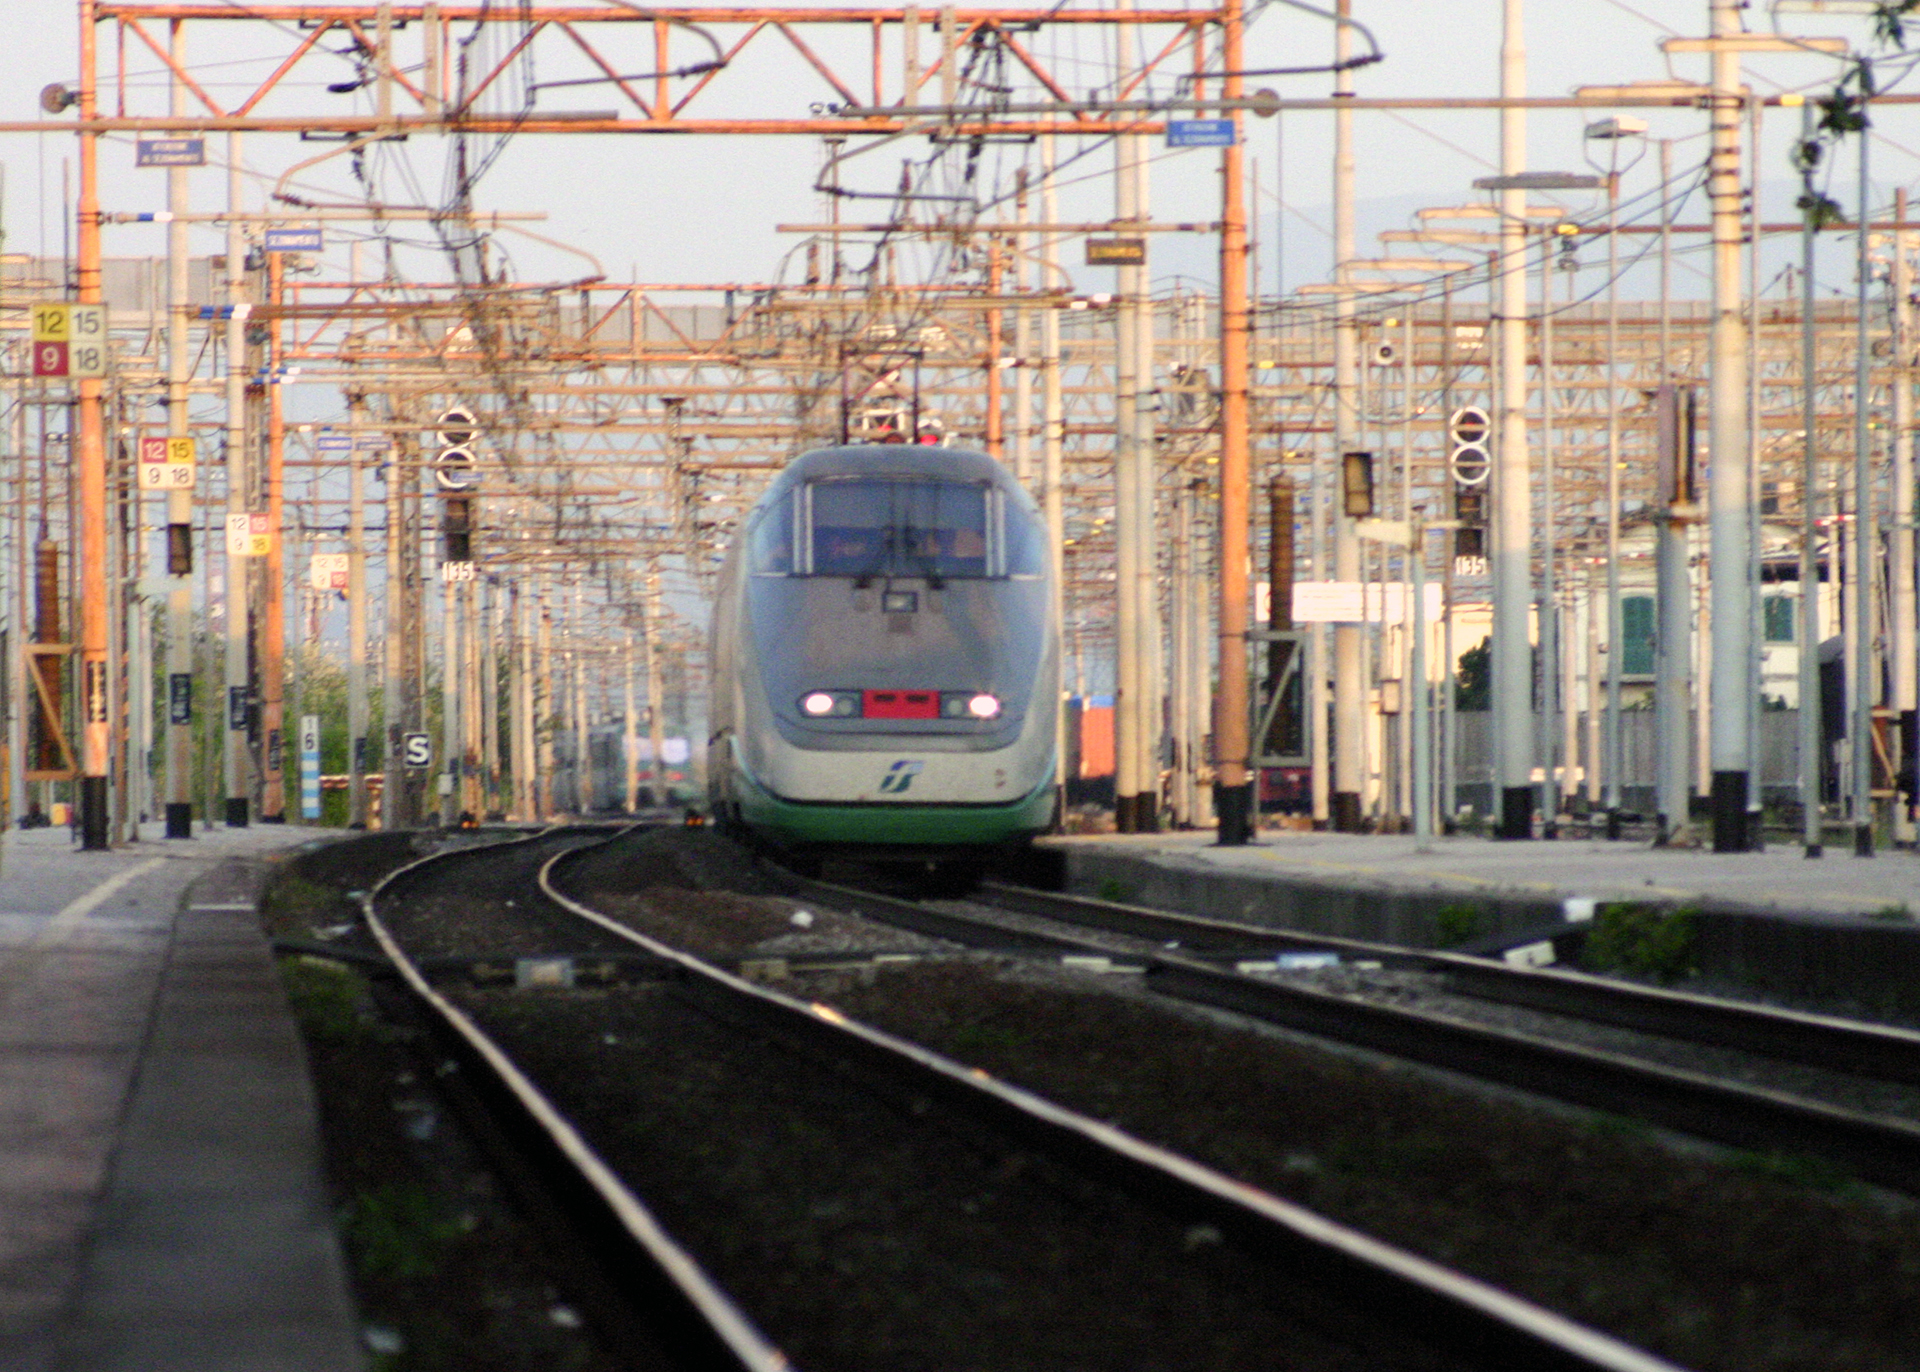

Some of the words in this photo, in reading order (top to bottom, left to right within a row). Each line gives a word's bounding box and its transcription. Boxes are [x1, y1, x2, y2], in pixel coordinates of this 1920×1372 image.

[37, 311, 63, 333] 12
[75, 311, 99, 334] 15
[42, 346, 59, 371] 9
[75, 348, 99, 370] 18
[145, 441, 165, 459] 12
[171, 442, 190, 458] 15
[149, 467, 160, 484] 9
[171, 467, 189, 484] 18
[231, 517, 246, 530] 12
[252, 517, 267, 531] 15
[235, 538, 243, 550] 9
[305, 733, 315, 750] 6
[408, 736, 428, 763] S
